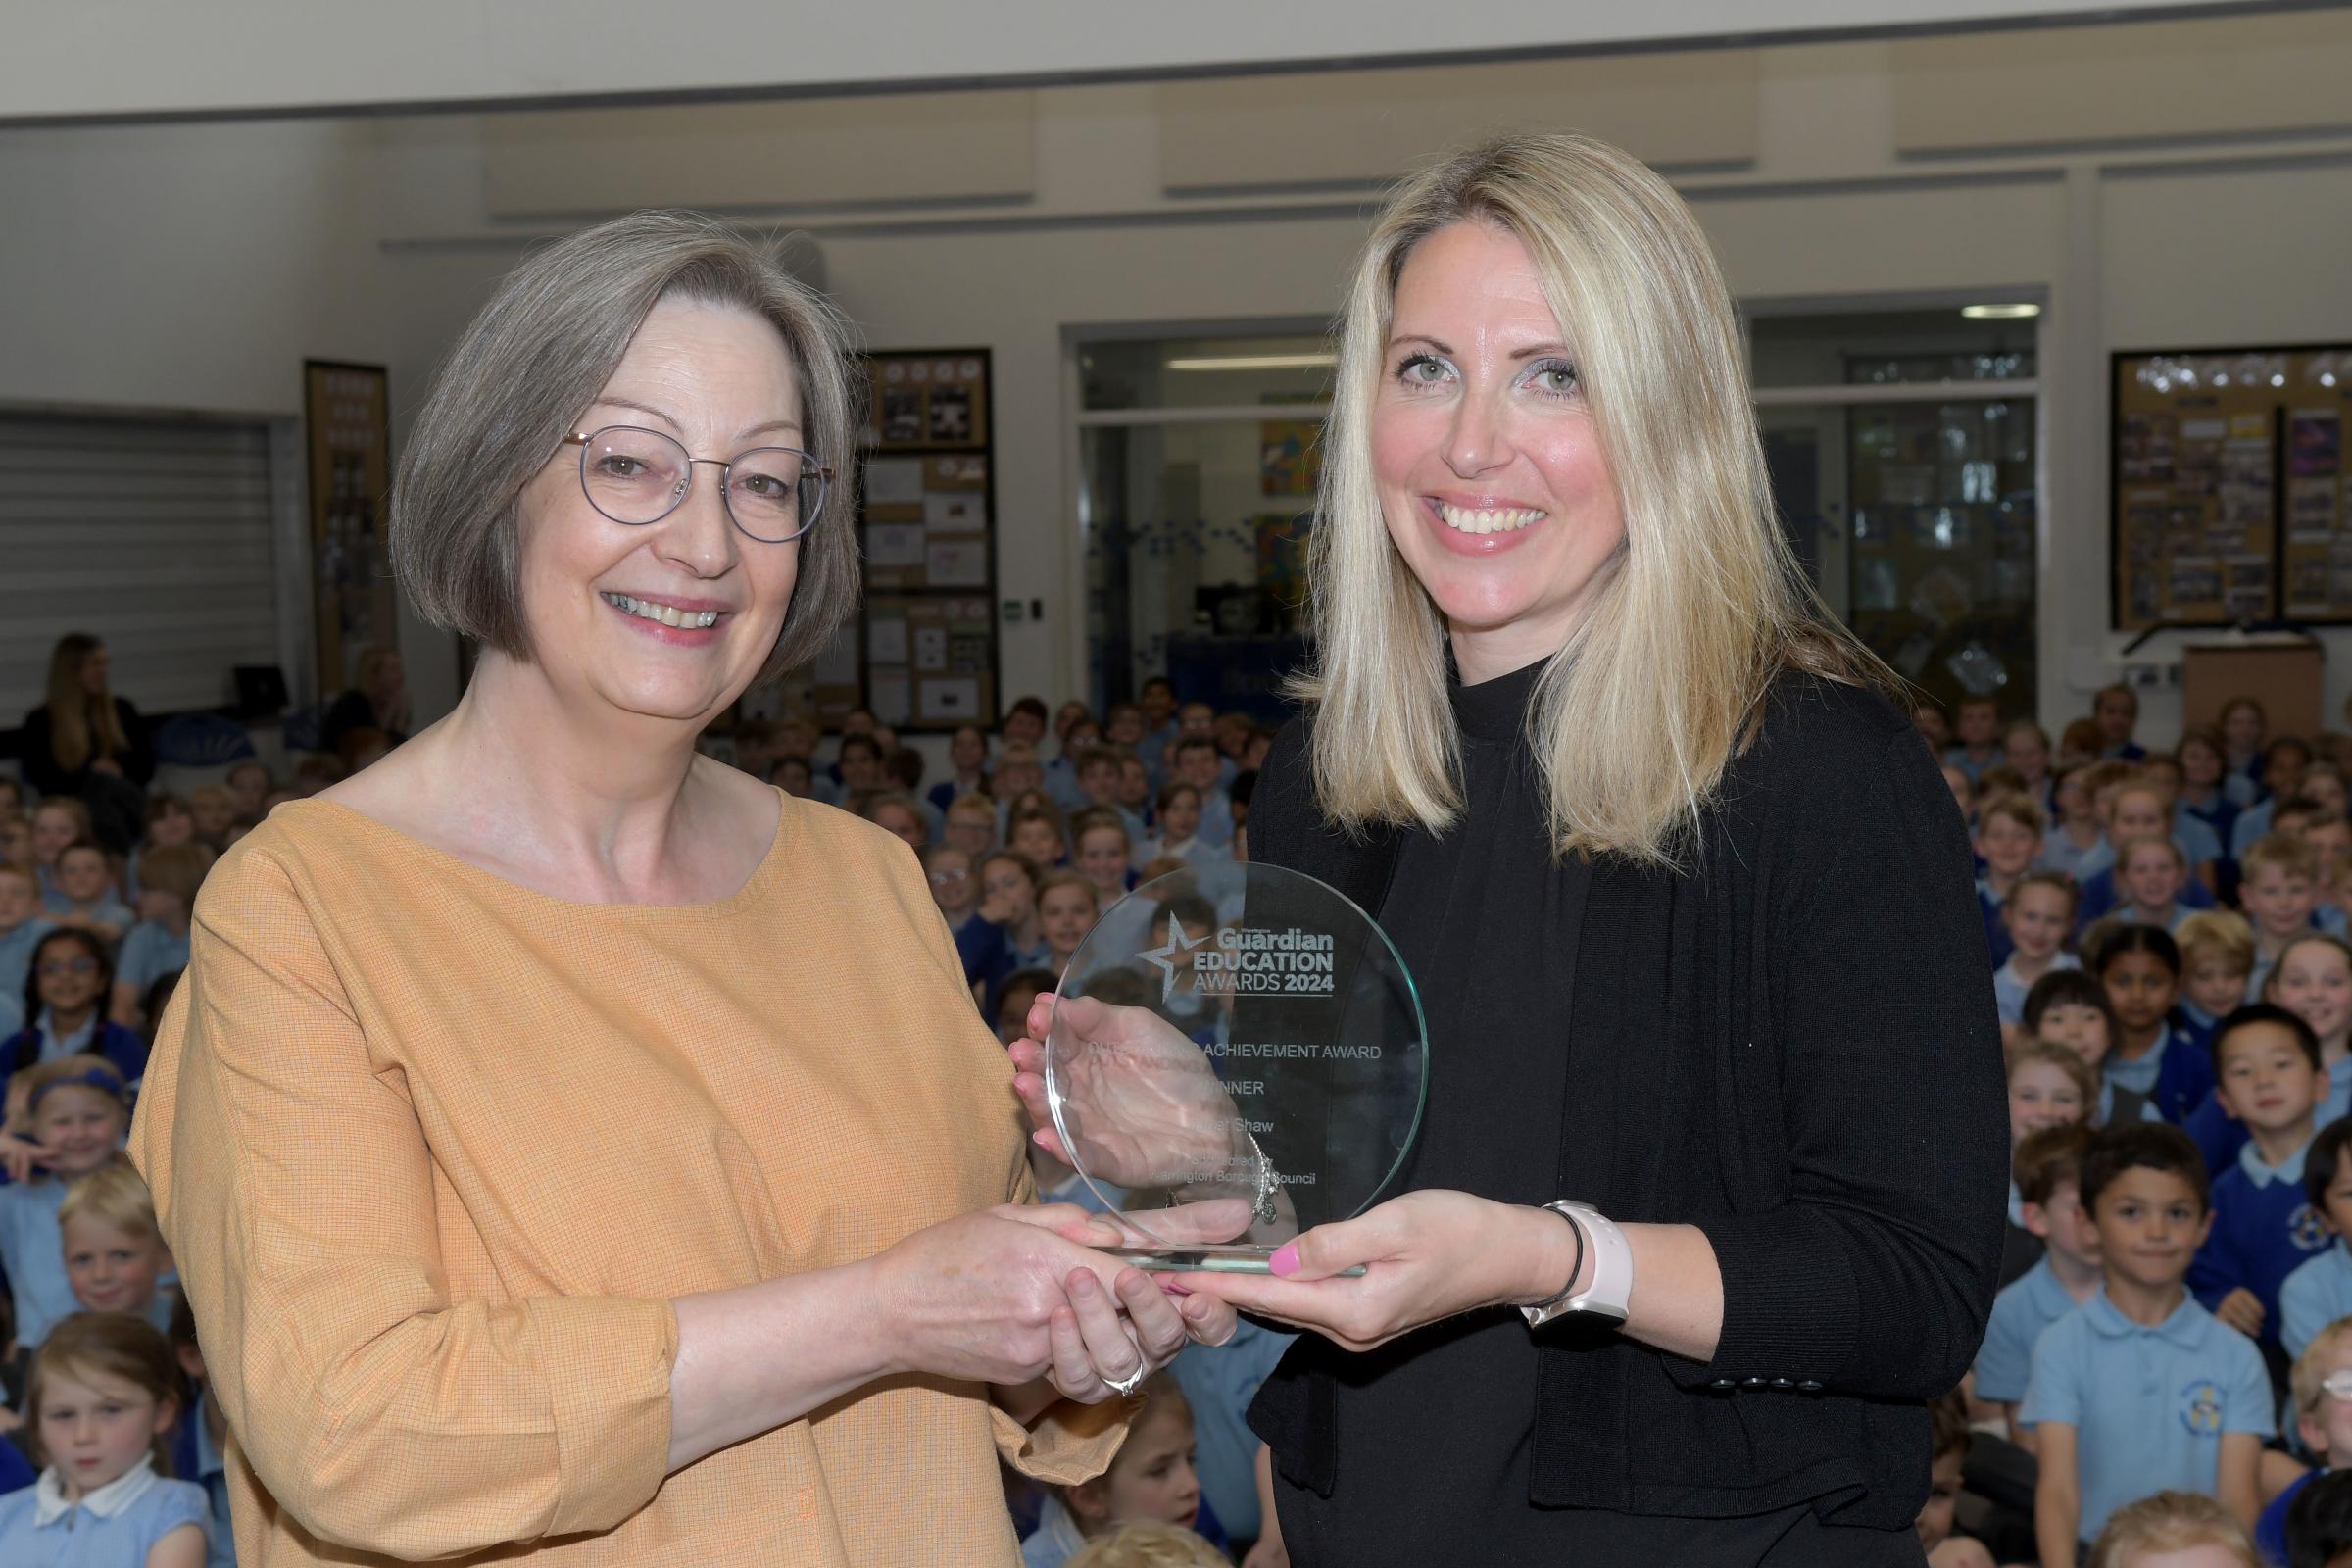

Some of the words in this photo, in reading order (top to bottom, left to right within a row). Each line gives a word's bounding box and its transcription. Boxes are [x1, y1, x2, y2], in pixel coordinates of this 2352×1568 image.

[1216, 927, 1334, 950] Guardian
[1193, 951, 1334, 972] EDUCATION
[1192, 972, 1281, 991] AWARDS
[1283, 973, 1335, 992] 2024
[1203, 1043, 1319, 1058] ACHIEVEMENT
[1321, 1044, 1383, 1059] AWARD
[1234, 1117, 1274, 1133] Shaw
[1216, 1170, 1268, 1186] Boroug
